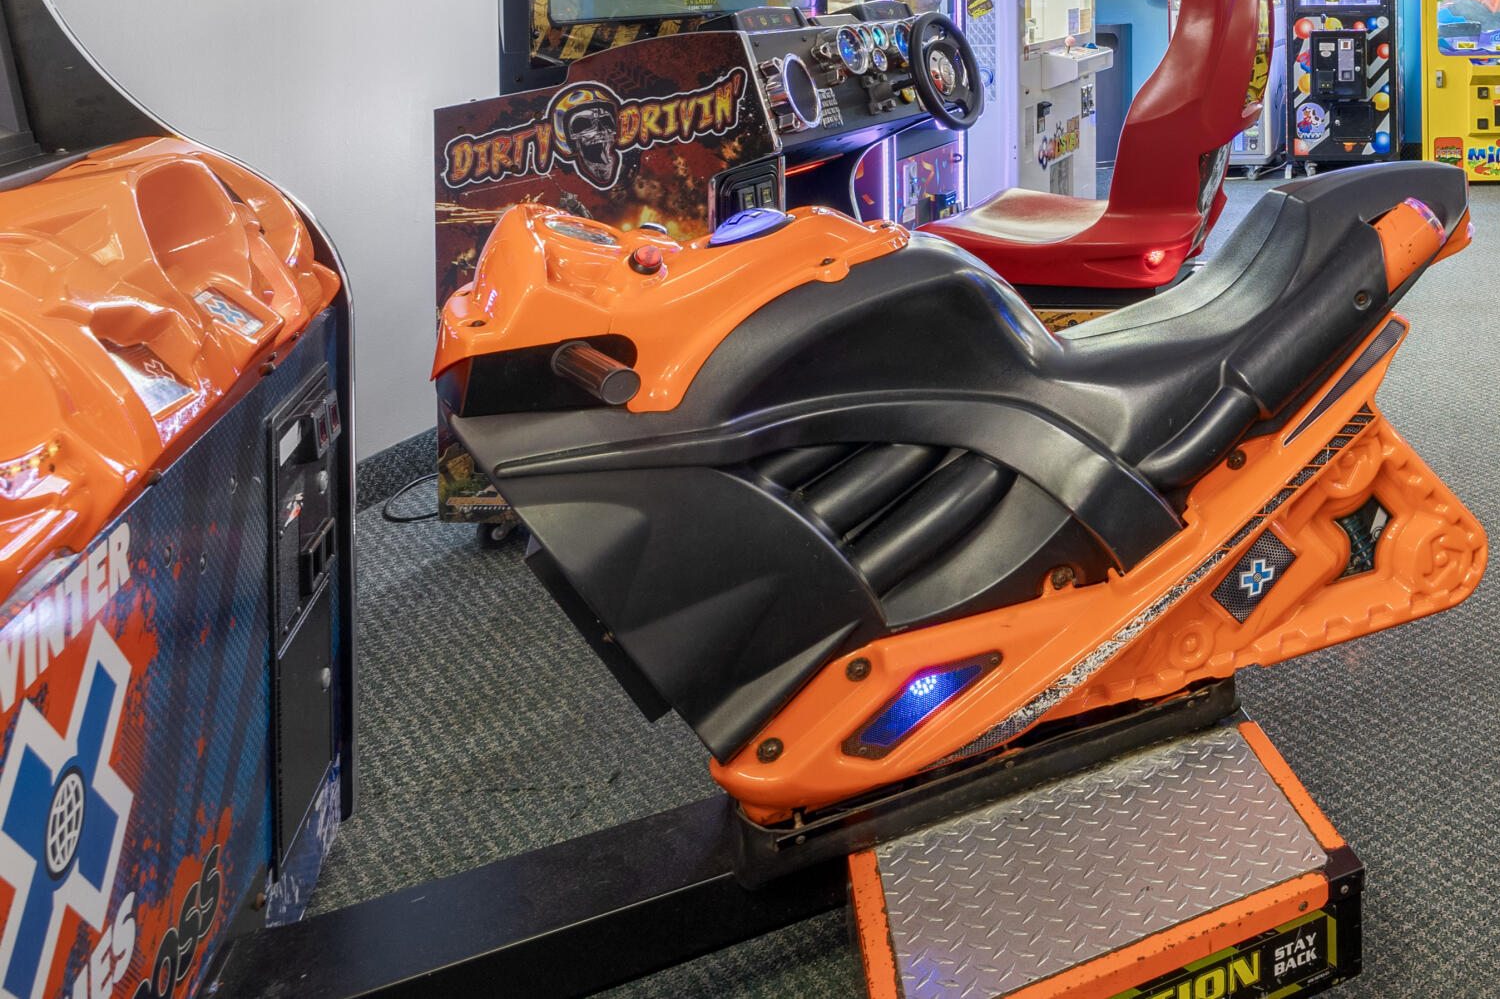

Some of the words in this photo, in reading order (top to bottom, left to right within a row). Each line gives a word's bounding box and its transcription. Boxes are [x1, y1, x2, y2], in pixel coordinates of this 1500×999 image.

[449, 122, 552, 183] DIRTY
[1274, 931, 1318, 962] STAY
[1274, 947, 1318, 978] BACK
